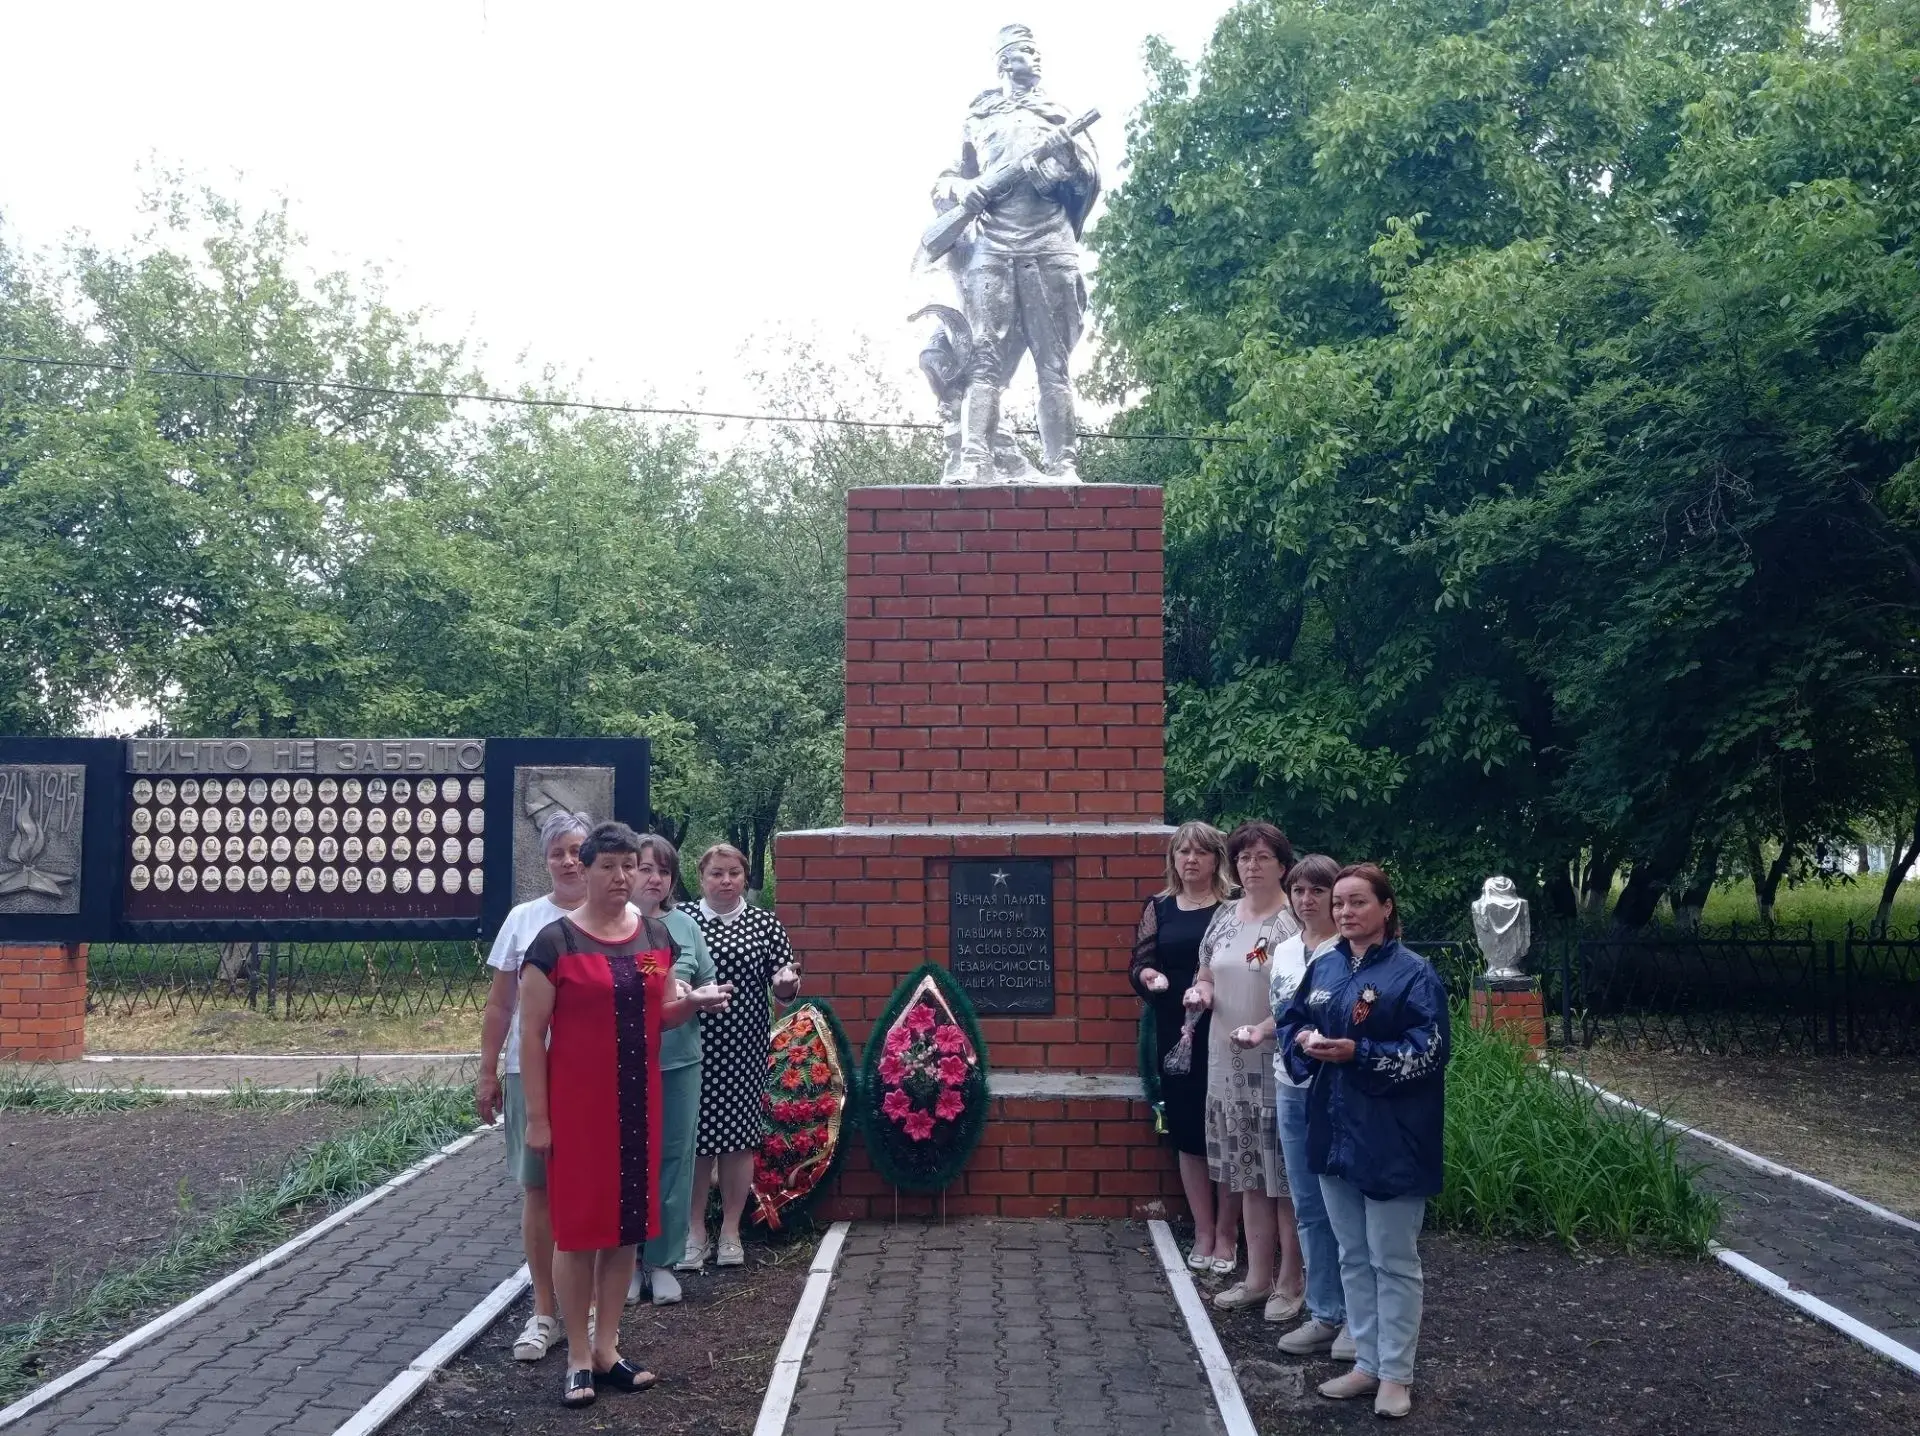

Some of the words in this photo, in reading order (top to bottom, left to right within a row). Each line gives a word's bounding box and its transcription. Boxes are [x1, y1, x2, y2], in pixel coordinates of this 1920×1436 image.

[132, 741, 251, 770] НИЧТО
[273, 741, 314, 770] НЕ
[336, 741, 485, 770] ЗАБЫТО
[0, 772, 23, 832] 941
[39, 772, 79, 833] 1945
[957, 927, 1003, 939] ПАВШИМ
[1016, 927, 1047, 938] БОЯХ
[958, 944, 971, 955] ЗА
[975, 943, 1032, 955] СВОБОДУ
